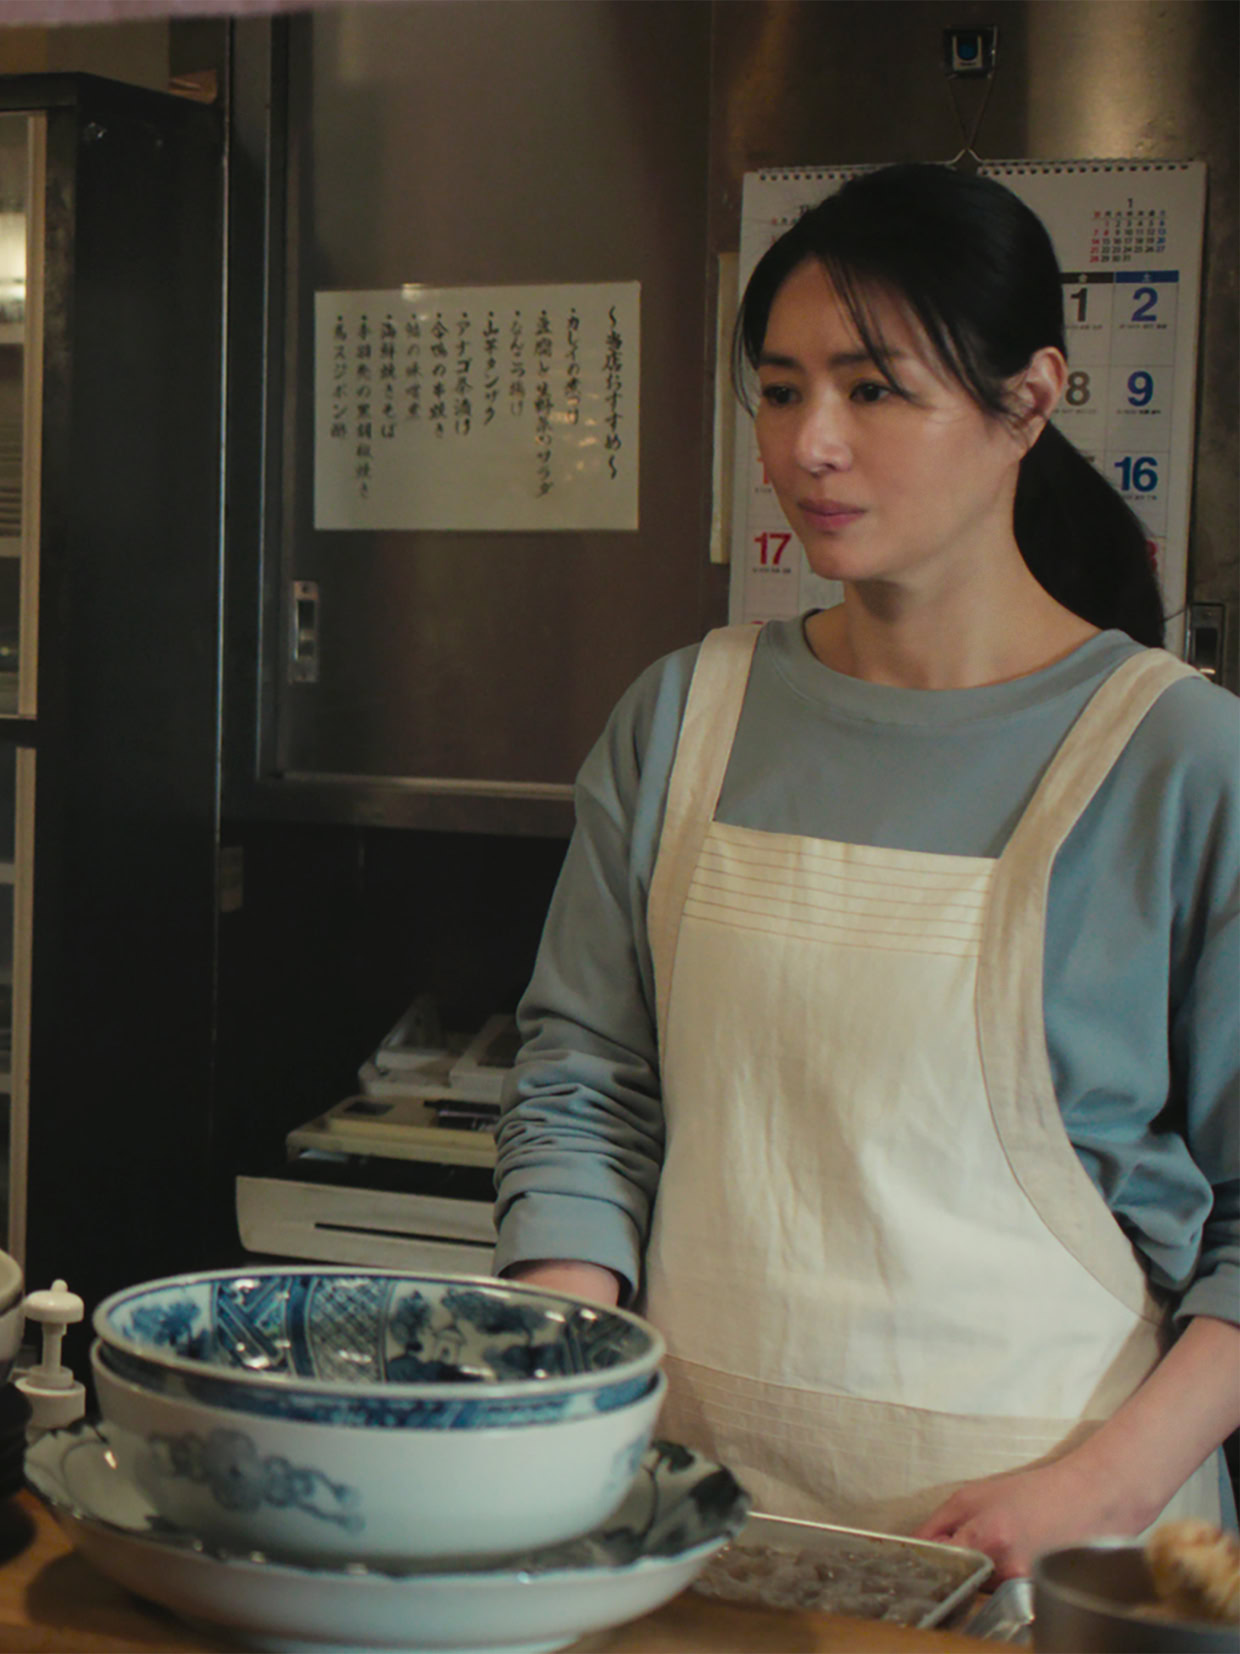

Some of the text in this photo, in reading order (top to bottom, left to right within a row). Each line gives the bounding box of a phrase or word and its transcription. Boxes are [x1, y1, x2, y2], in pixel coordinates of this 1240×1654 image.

[1070, 287, 1159, 322] 1 2
[1064, 371, 1154, 406] 8 9
[1114, 456, 1159, 492] 16
[754, 531, 792, 565] 17
